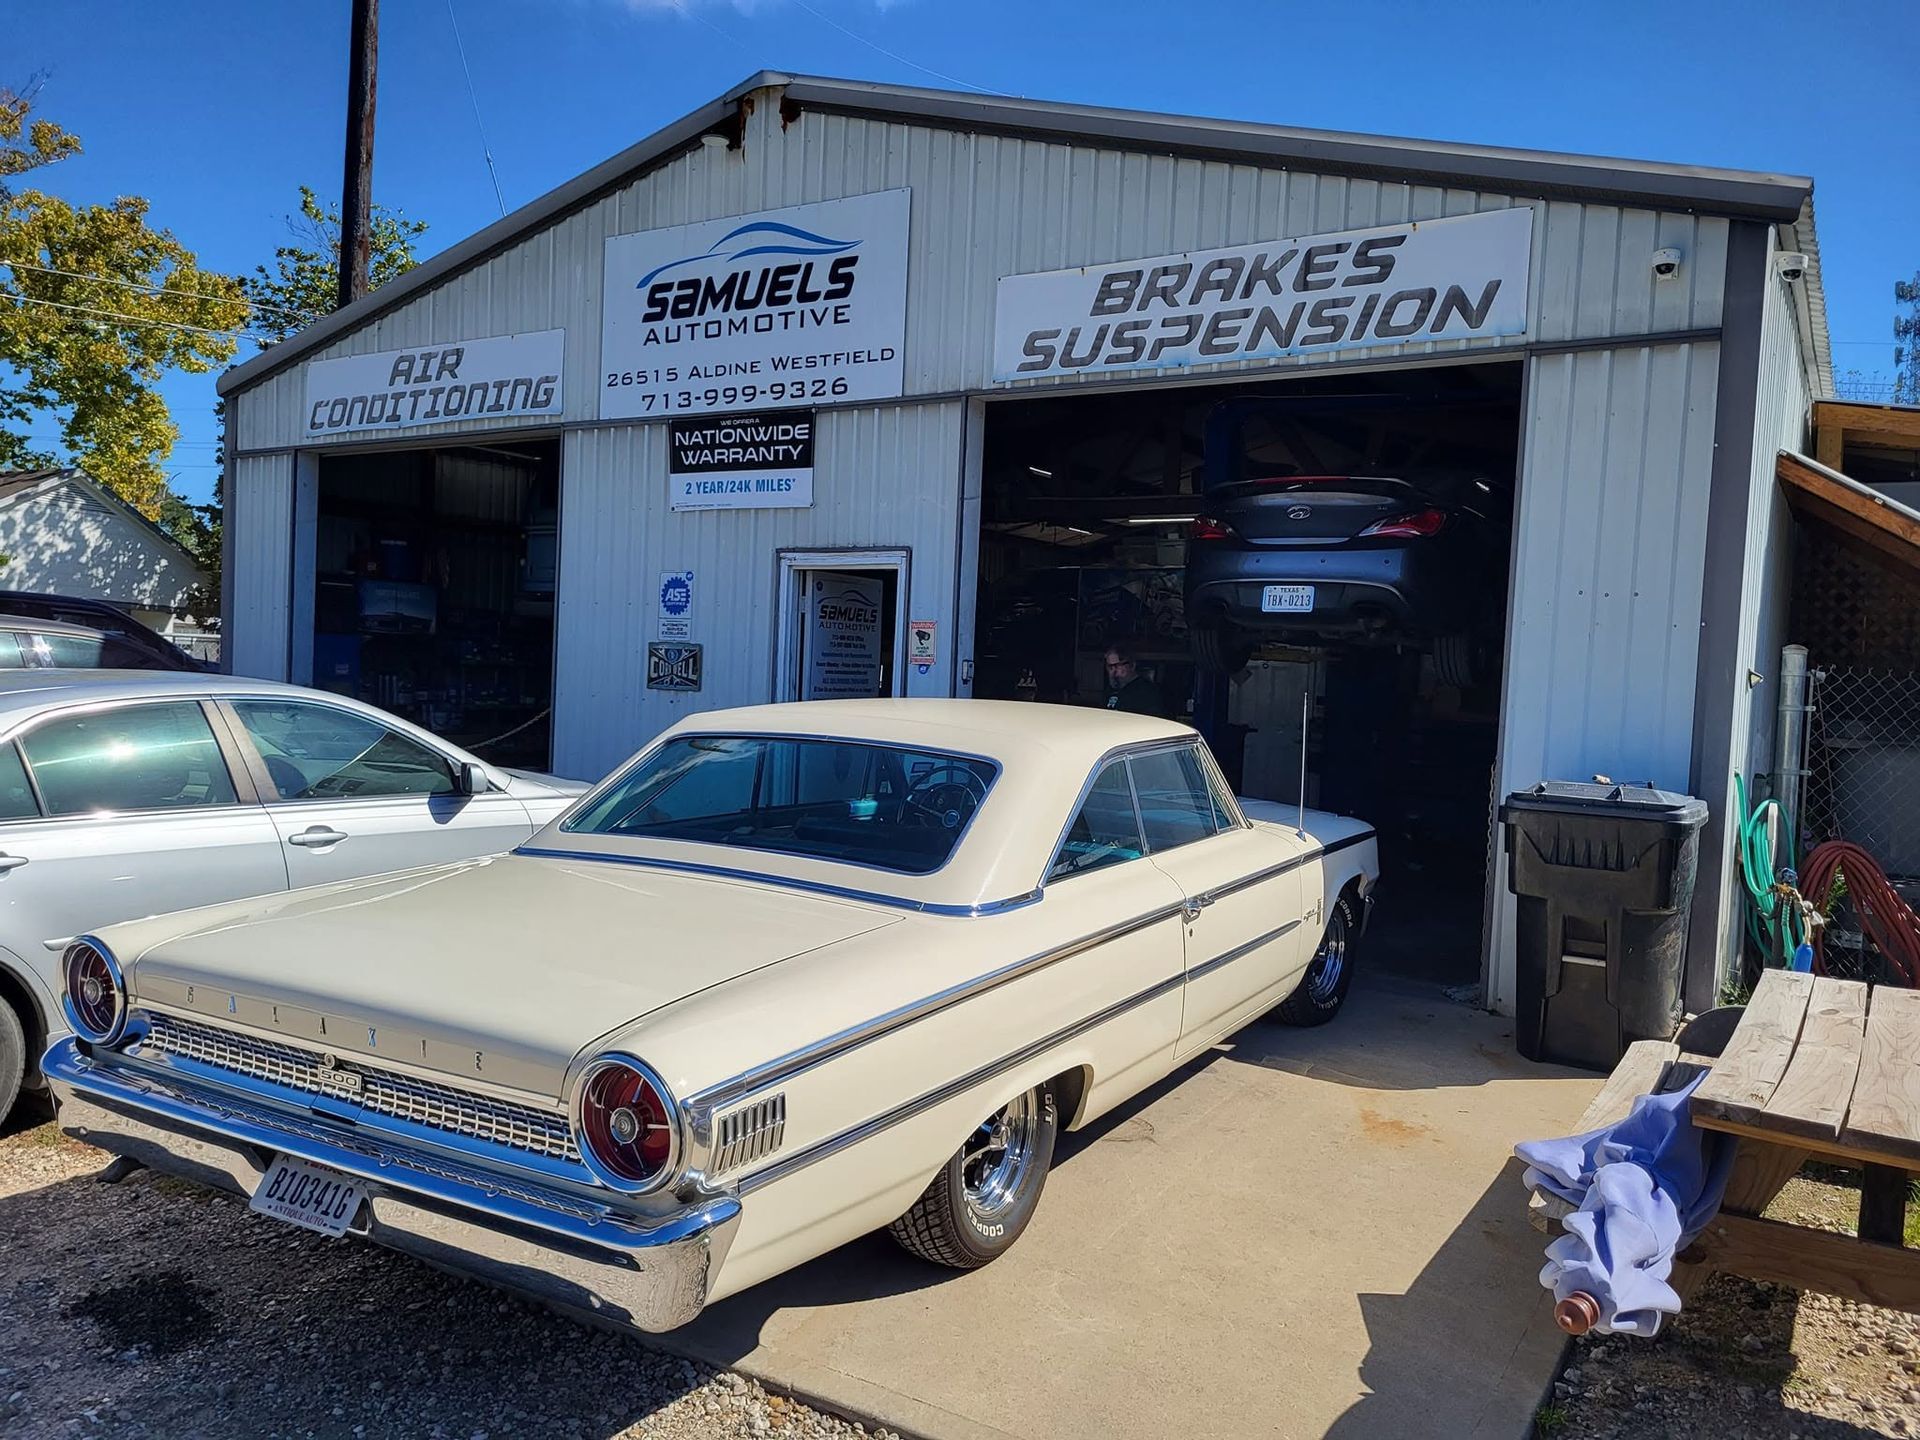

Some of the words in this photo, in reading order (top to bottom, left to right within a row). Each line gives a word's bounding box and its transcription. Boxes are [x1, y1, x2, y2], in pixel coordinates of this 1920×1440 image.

[1089, 234, 1408, 317] BRAKES
[643, 304, 851, 346] AUTOMOTIVE
[1015, 279, 1502, 373] SUSPENSION
[388, 347, 465, 387] AIR
[607, 367, 679, 388] 26515
[688, 360, 761, 380] ALDINE
[771, 347, 895, 371] WESTFIELD
[310, 375, 558, 430] CONDITIONING
[641, 377, 848, 411] 713-999-9326
[675, 424, 810, 447] NATIONWIDE
[680, 444, 804, 466] WARRANTY
[685, 482, 692, 495] 2
[696, 479, 752, 494] YEAR/24K
[665, 588, 687, 602] ASE
[819, 622, 877, 633] AUTOMOTIVE
[1339, 900, 1354, 928] COBRA
[321, 1069, 357, 1087] 500
[265, 1166, 354, 1219] B10341G
[273, 1205, 306, 1220] ANTIQUE
[304, 1214, 325, 1226] AUTO
[967, 1206, 1004, 1237] COOPER
